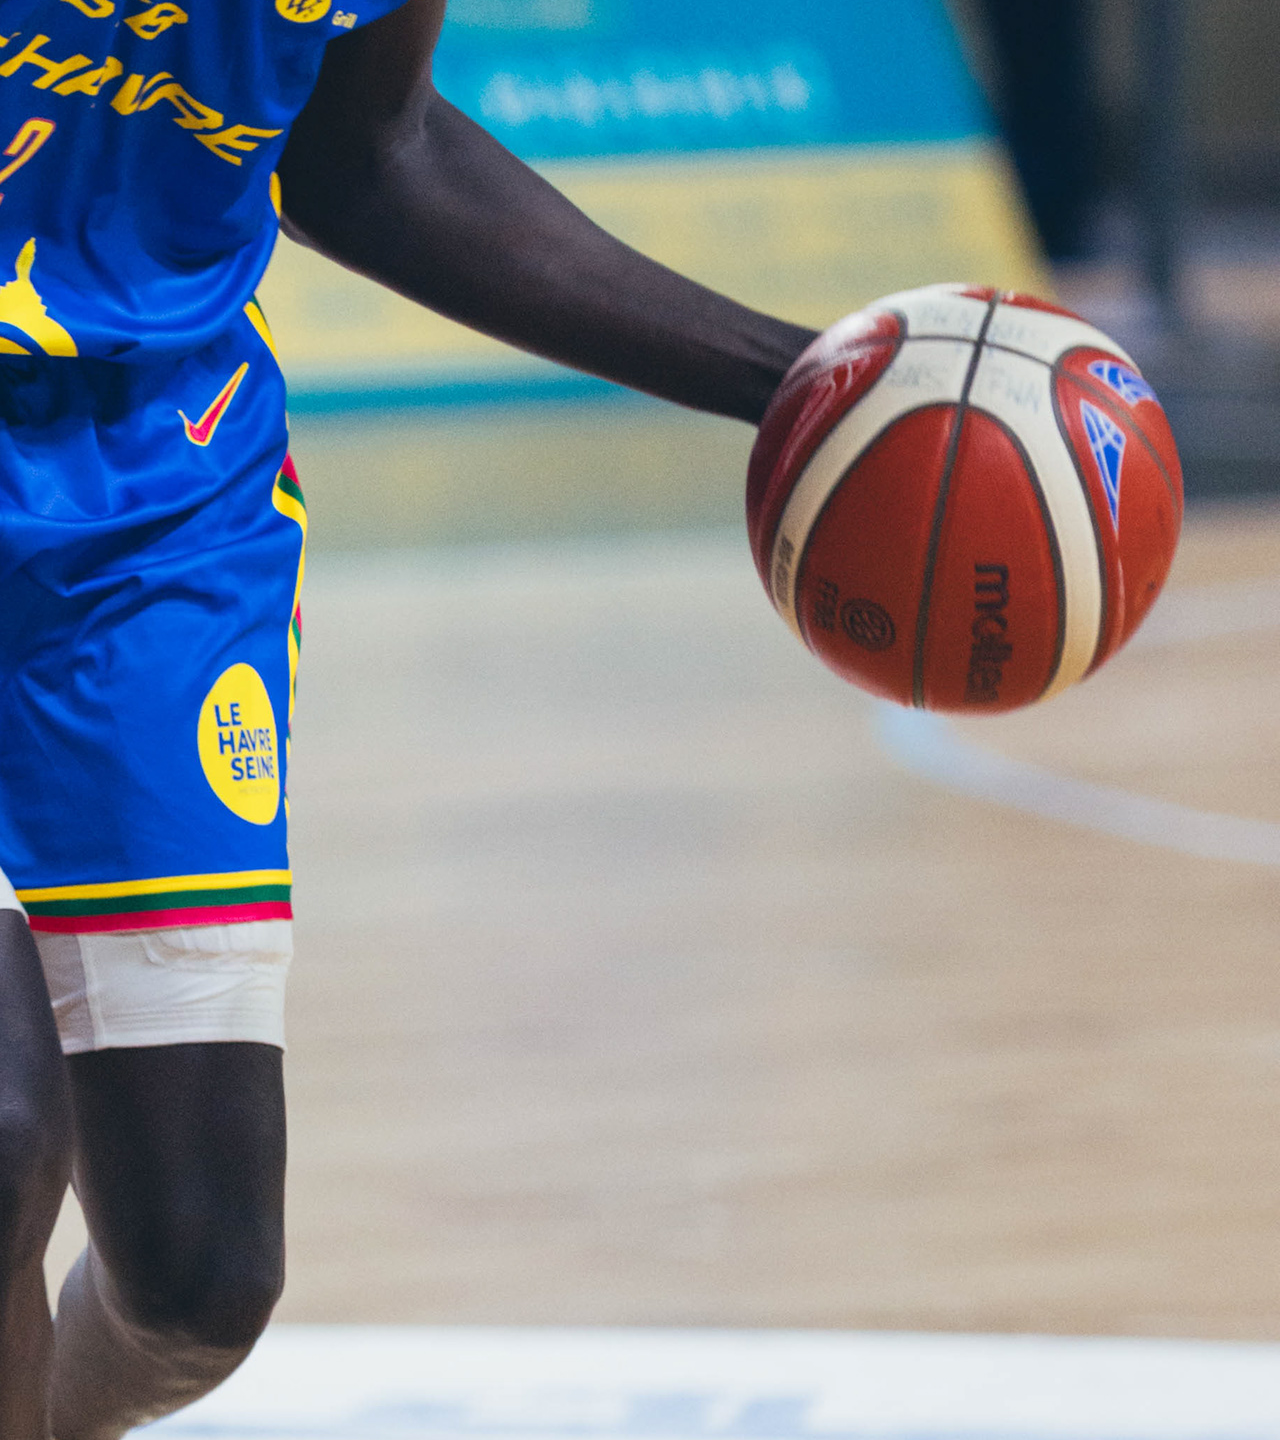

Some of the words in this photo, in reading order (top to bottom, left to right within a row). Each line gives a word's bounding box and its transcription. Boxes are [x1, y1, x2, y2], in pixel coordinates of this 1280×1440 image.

[214, 702, 242, 727] LE
[217, 727, 273, 755] HAVRE
[230, 755, 275, 782] SEINE
